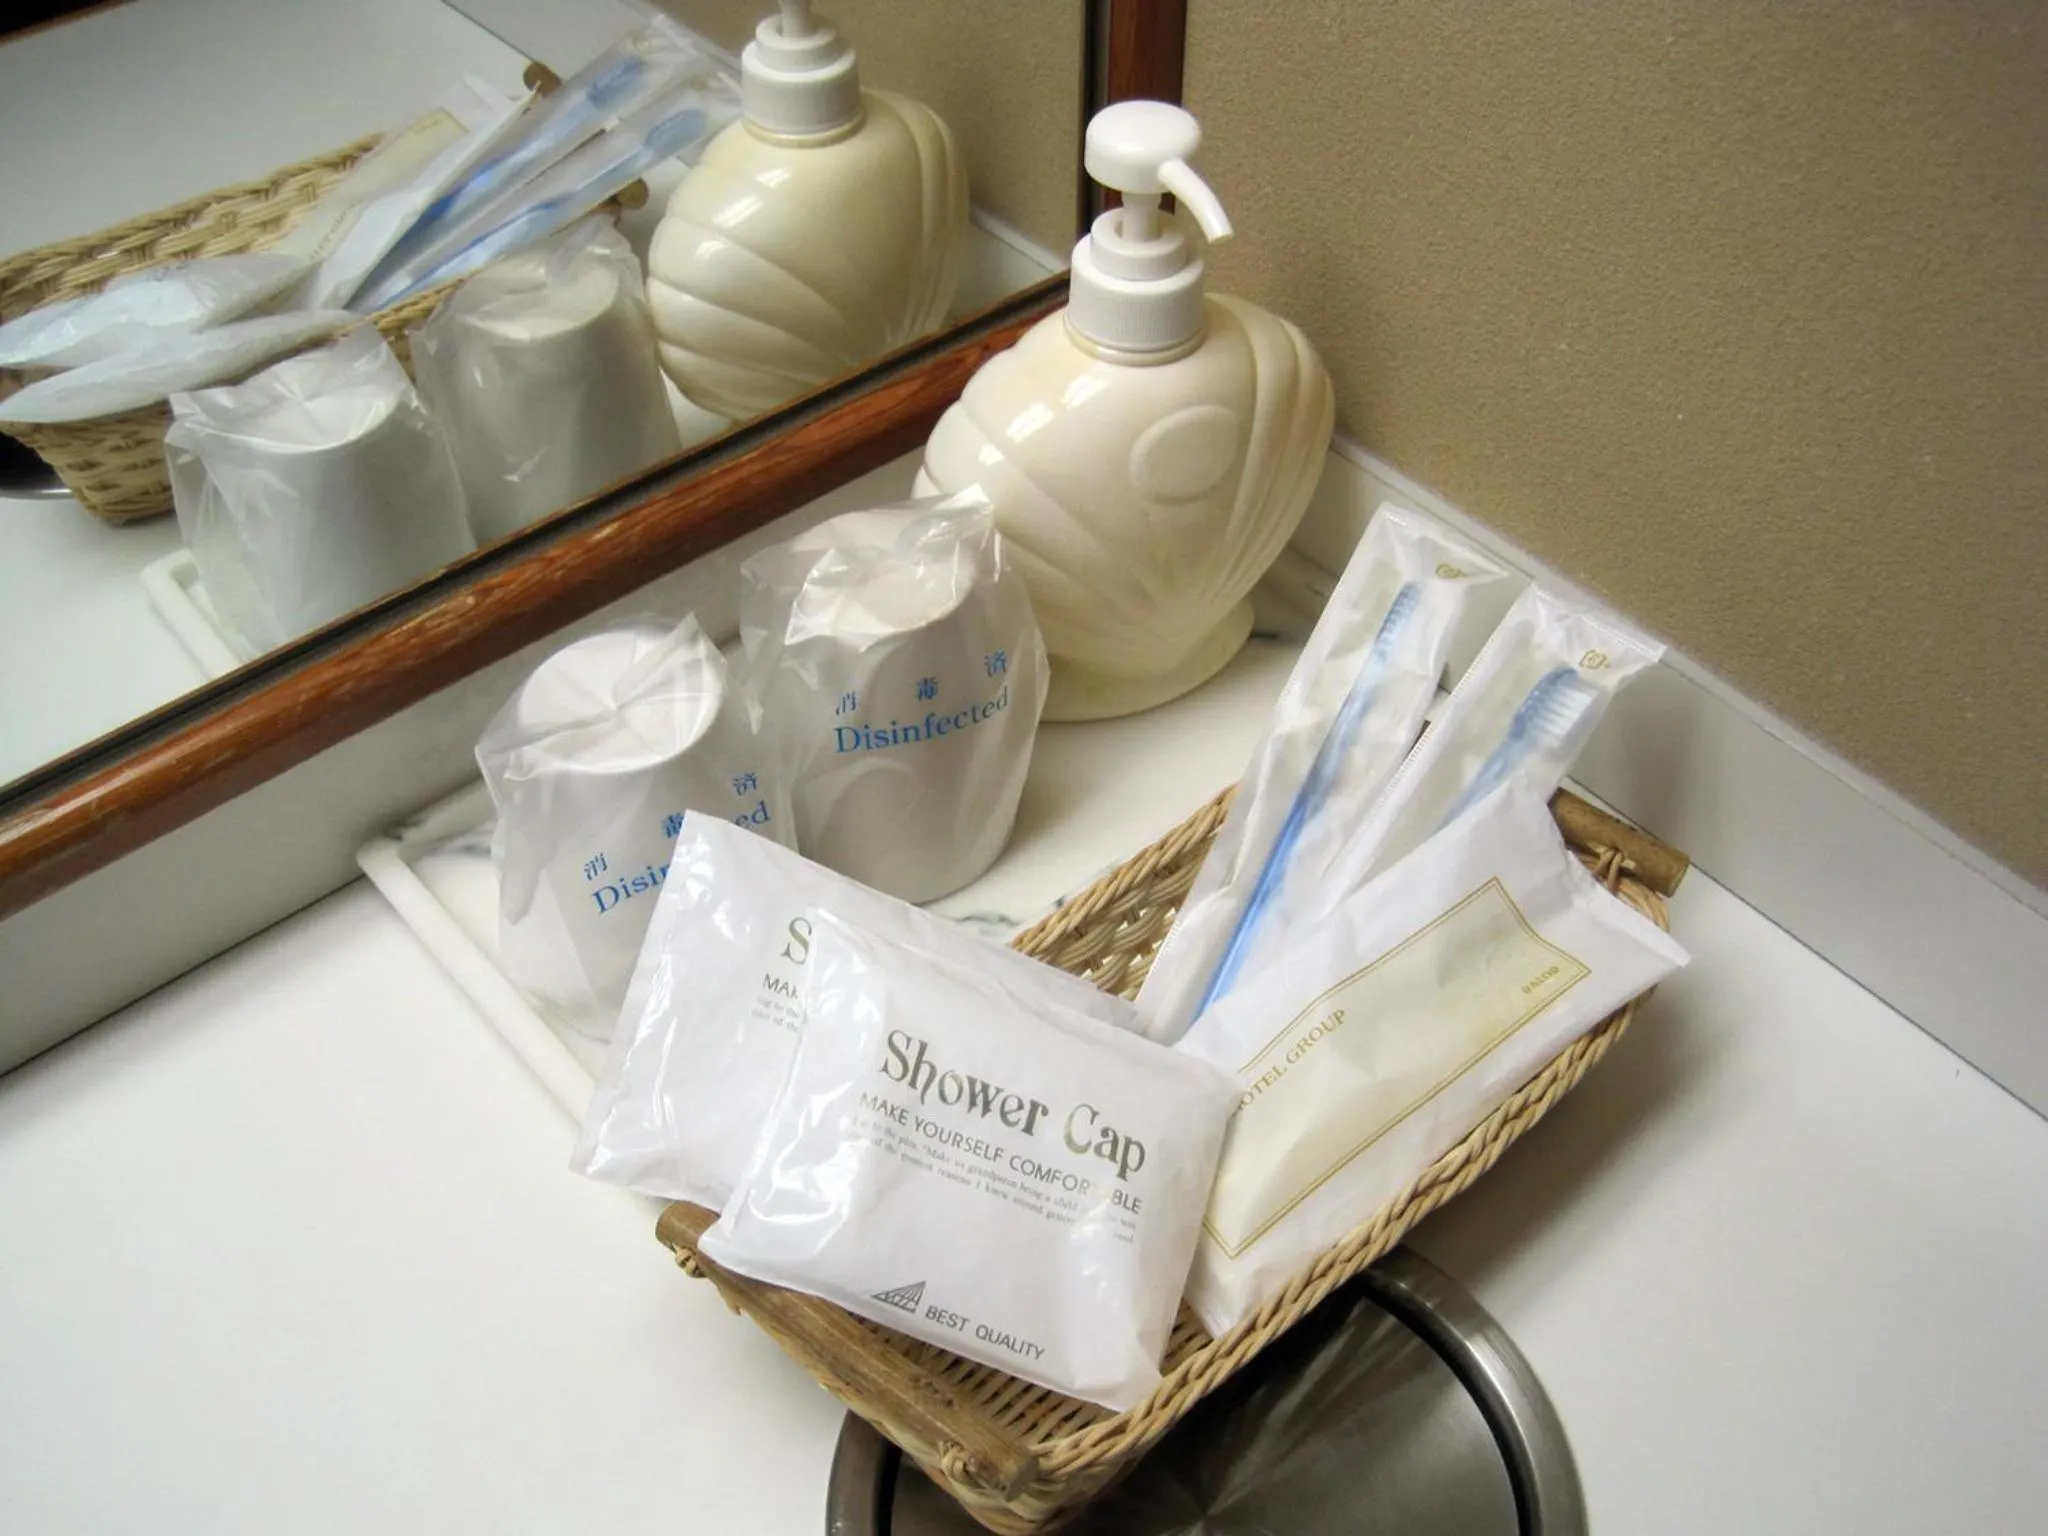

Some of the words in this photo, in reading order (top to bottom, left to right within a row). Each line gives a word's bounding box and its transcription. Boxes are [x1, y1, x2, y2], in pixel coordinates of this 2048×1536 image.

[834, 685, 1008, 754] Disinfected
[879, 1028, 1049, 1137] Shower
[1063, 1102, 1146, 1182] Cap
[1238, 1065, 1288, 1109] OTEL
[1286, 1008, 1345, 1064] GROUP
[859, 1091, 909, 1126] MAKE
[914, 1115, 1004, 1163] YOURSELF
[1008, 1154, 1143, 1215] COMFORBLE
[925, 1304, 970, 1332] BEST
[974, 1324, 1046, 1361] QUALITY
